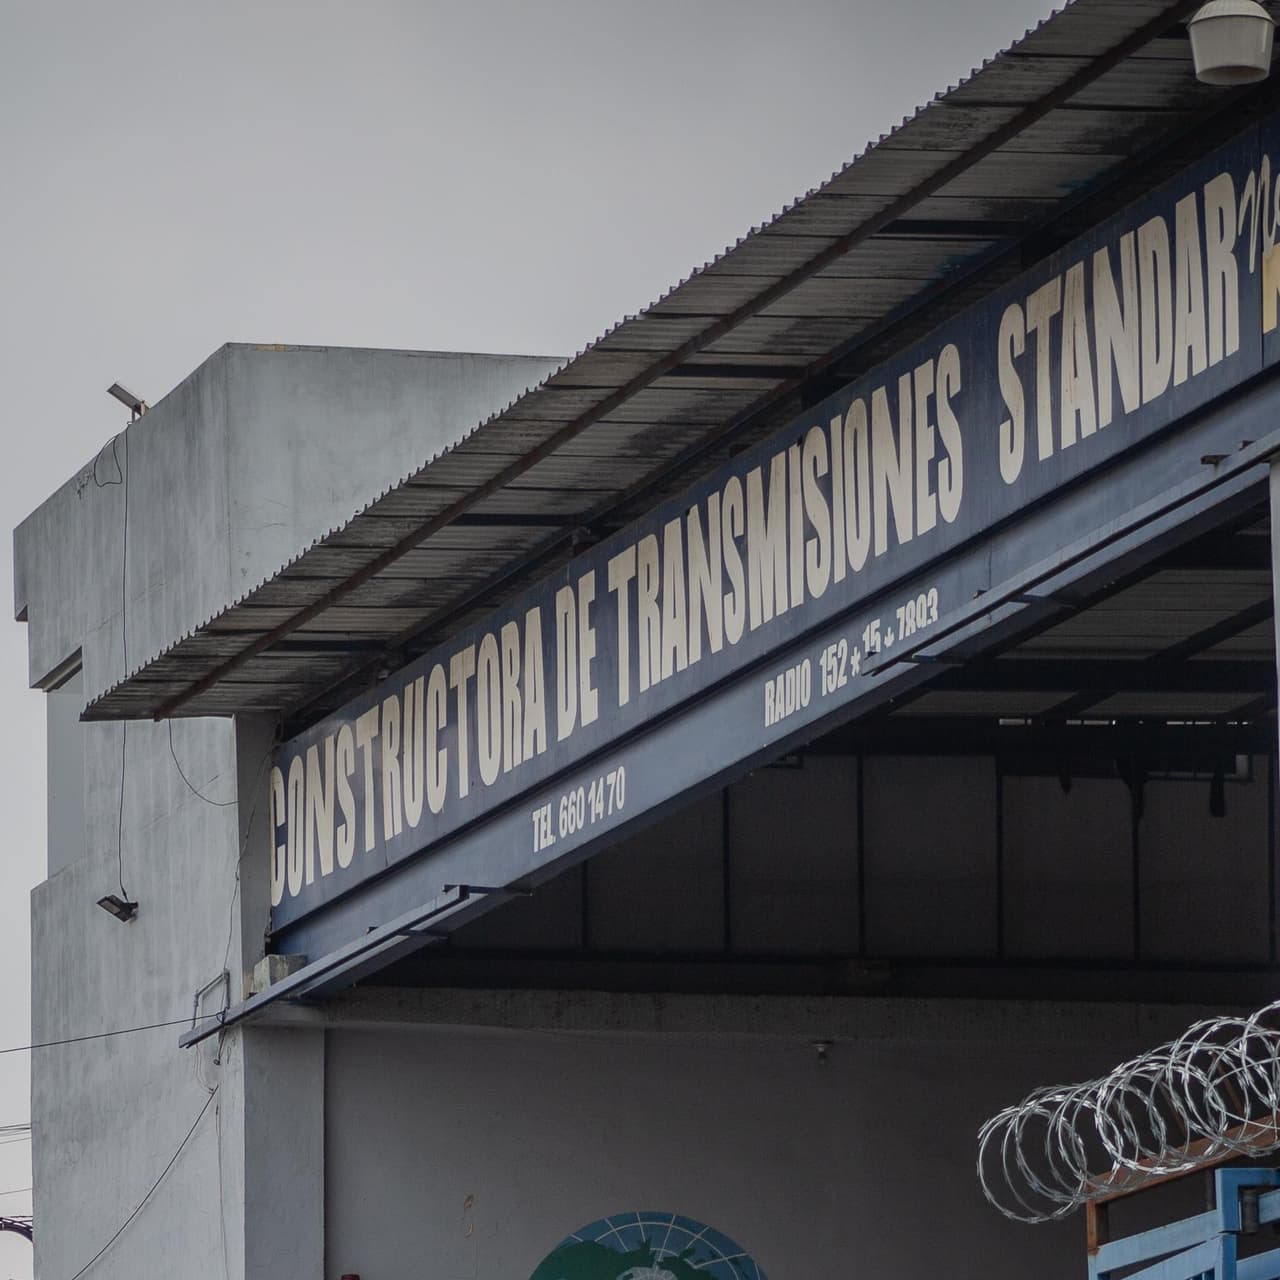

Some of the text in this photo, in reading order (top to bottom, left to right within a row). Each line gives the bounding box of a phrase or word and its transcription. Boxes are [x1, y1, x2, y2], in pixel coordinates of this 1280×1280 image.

[270, 172, 1240, 907] CONSTRUCTORA DE TRANSMISIONES STANDAR
[765, 658, 811, 727] RADIO
[559, 786, 585, 838] 660
[588, 776, 604, 823] 14
[607, 766, 625, 815] 70
